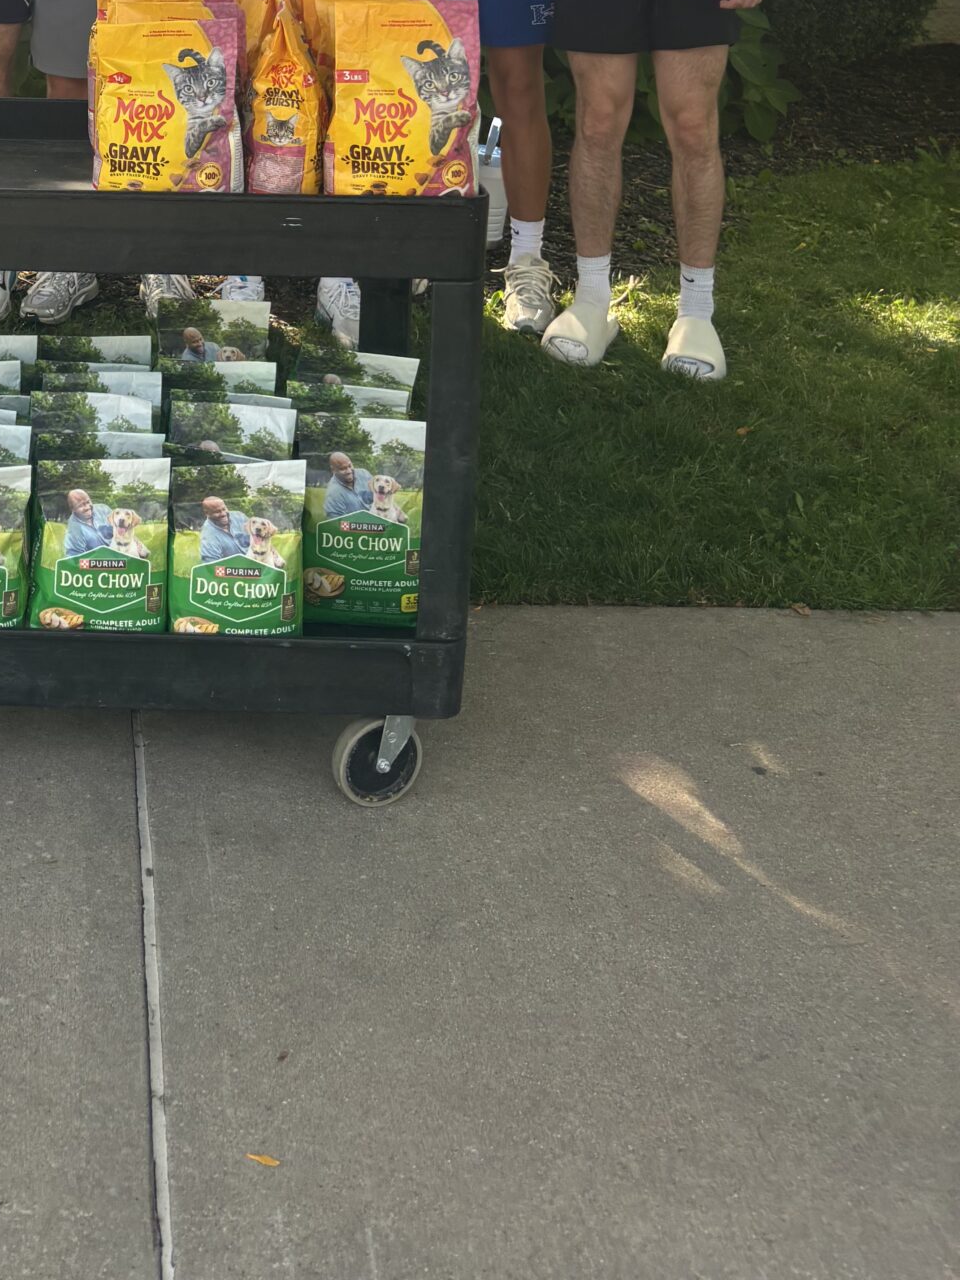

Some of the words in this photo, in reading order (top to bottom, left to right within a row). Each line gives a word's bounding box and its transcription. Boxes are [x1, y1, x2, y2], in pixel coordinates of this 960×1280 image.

[265, 87, 300, 100] GRAVY
[265, 97, 300, 110] BURSTS
[108, 142, 161, 162] GRAVY
[349, 144, 405, 161] GRAVY
[109, 159, 161, 177] BURSTS
[351, 160, 406, 177] BURSTS
[350, 523, 384, 531] PURINA
[90, 560, 125, 568] PURINA
[226, 568, 260, 576] PURINA
[350, 578, 392, 587] COMPLETE
[89, 619, 133, 627] COMPLETE
[135, 616, 161, 626] ADULT
[224, 627, 269, 636] COMPLETE
[270, 624, 296, 635] ADULT
